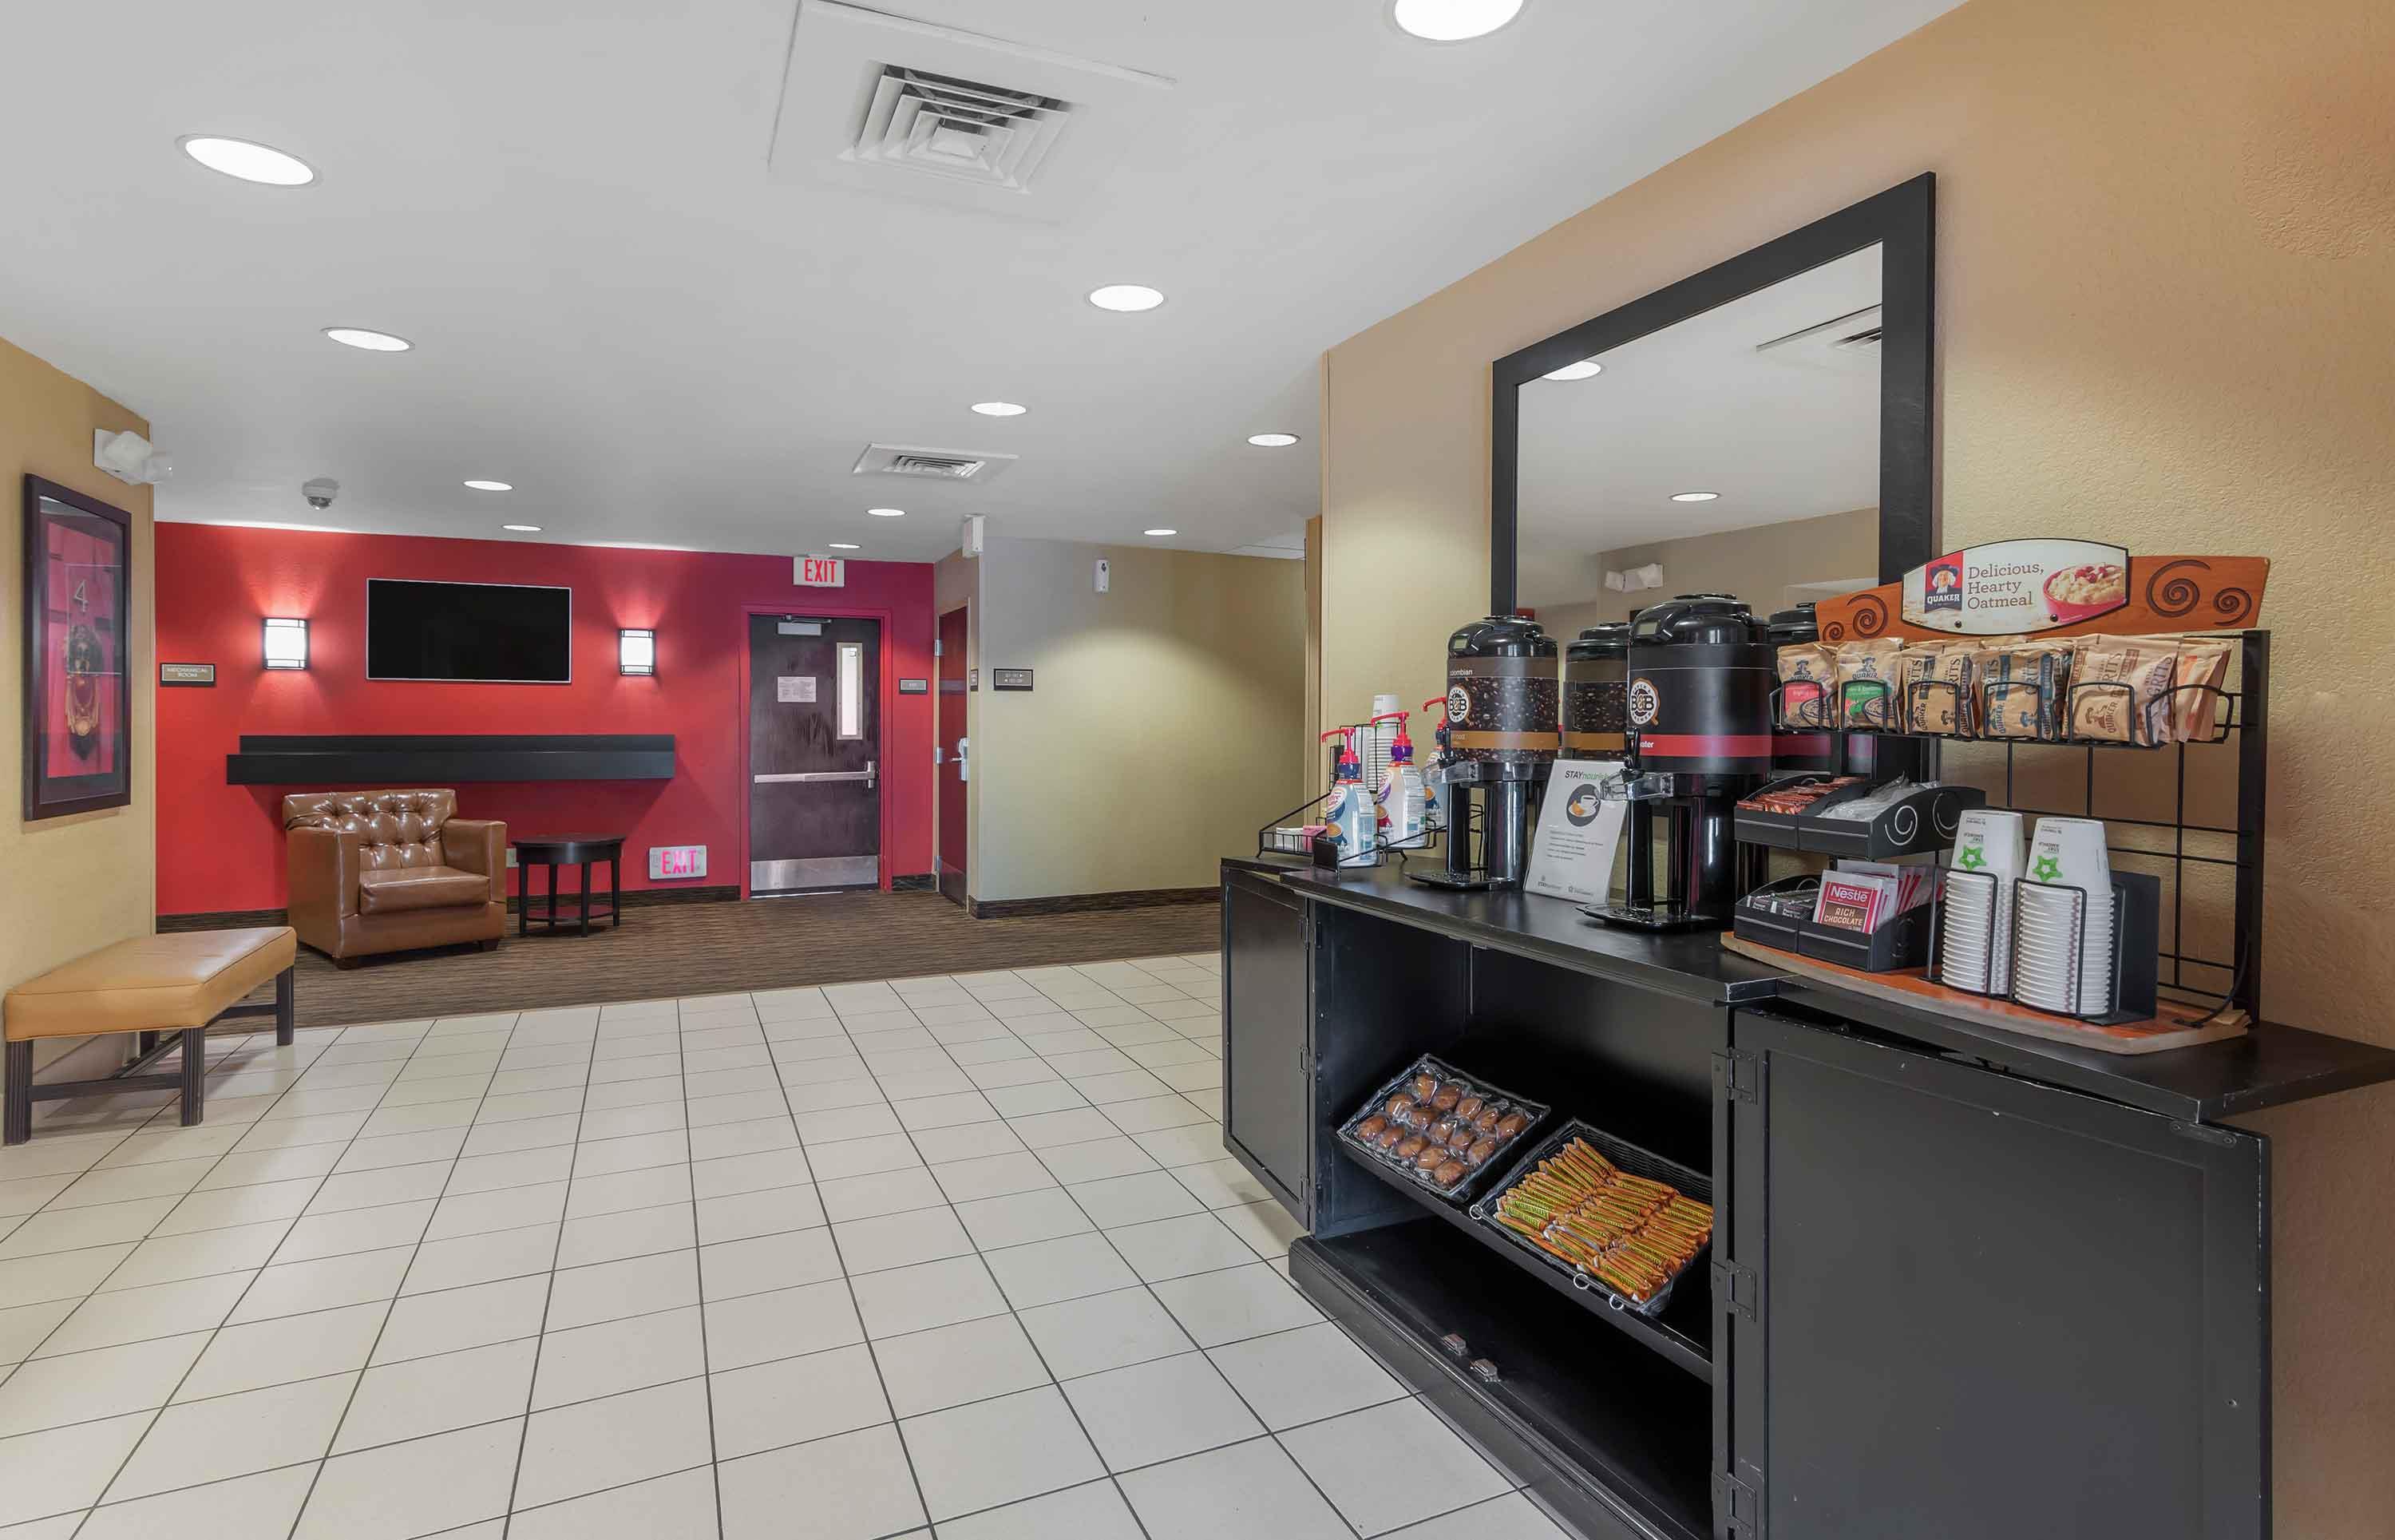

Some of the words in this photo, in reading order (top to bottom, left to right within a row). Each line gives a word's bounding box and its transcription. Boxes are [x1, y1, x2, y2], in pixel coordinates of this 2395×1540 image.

[805, 559, 837, 583] EXIT
[1968, 563, 2045, 580] Delicious,
[1967, 580, 2022, 595] Hearty
[1926, 593, 1961, 604] QUAKER
[1967, 592, 2033, 609] Oatmeal
[1918, 703, 1928, 731] QUAKER
[1996, 704, 2006, 734] QUAKER
[2105, 702, 2119, 734] QUAKER
[661, 849, 696, 875] EXIT
[1824, 915, 1863, 926] CHOCOLATE
[1835, 907, 1856, 917] RICH
